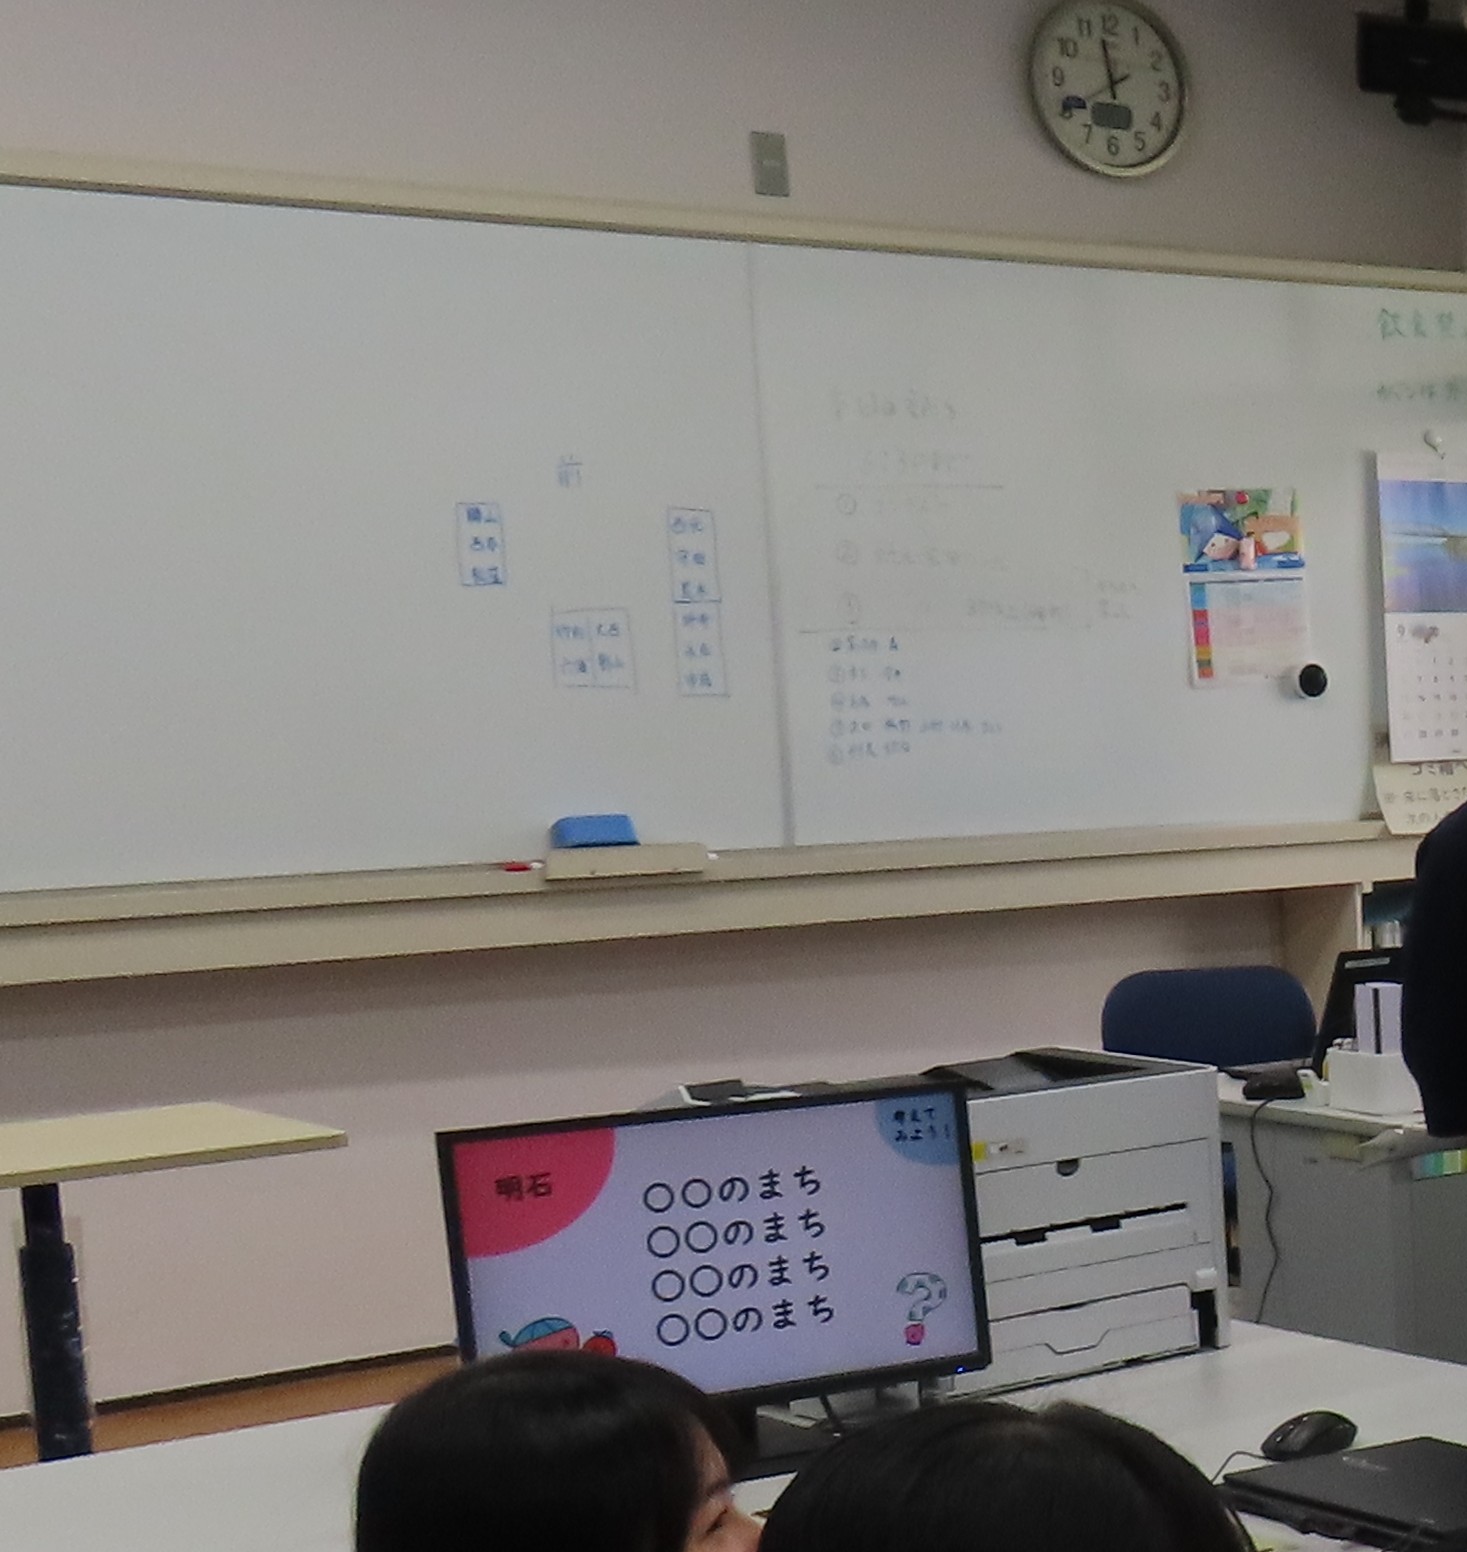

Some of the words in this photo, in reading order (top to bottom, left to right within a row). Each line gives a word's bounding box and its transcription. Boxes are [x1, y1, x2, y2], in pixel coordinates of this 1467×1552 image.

[1078, 18, 1091, 37] 11
[1103, 14, 1119, 36] 12
[1057, 37, 1079, 58] 10
[1150, 51, 1162, 71] 2
[1052, 66, 1064, 87] 9
[1159, 81, 1170, 103] 3
[1151, 111, 1162, 132] 4
[1083, 123, 1093, 144] 7
[1134, 131, 1147, 151] 5
[1107, 136, 1120, 156] 6
[494, 1172, 553, 1201] 明石
